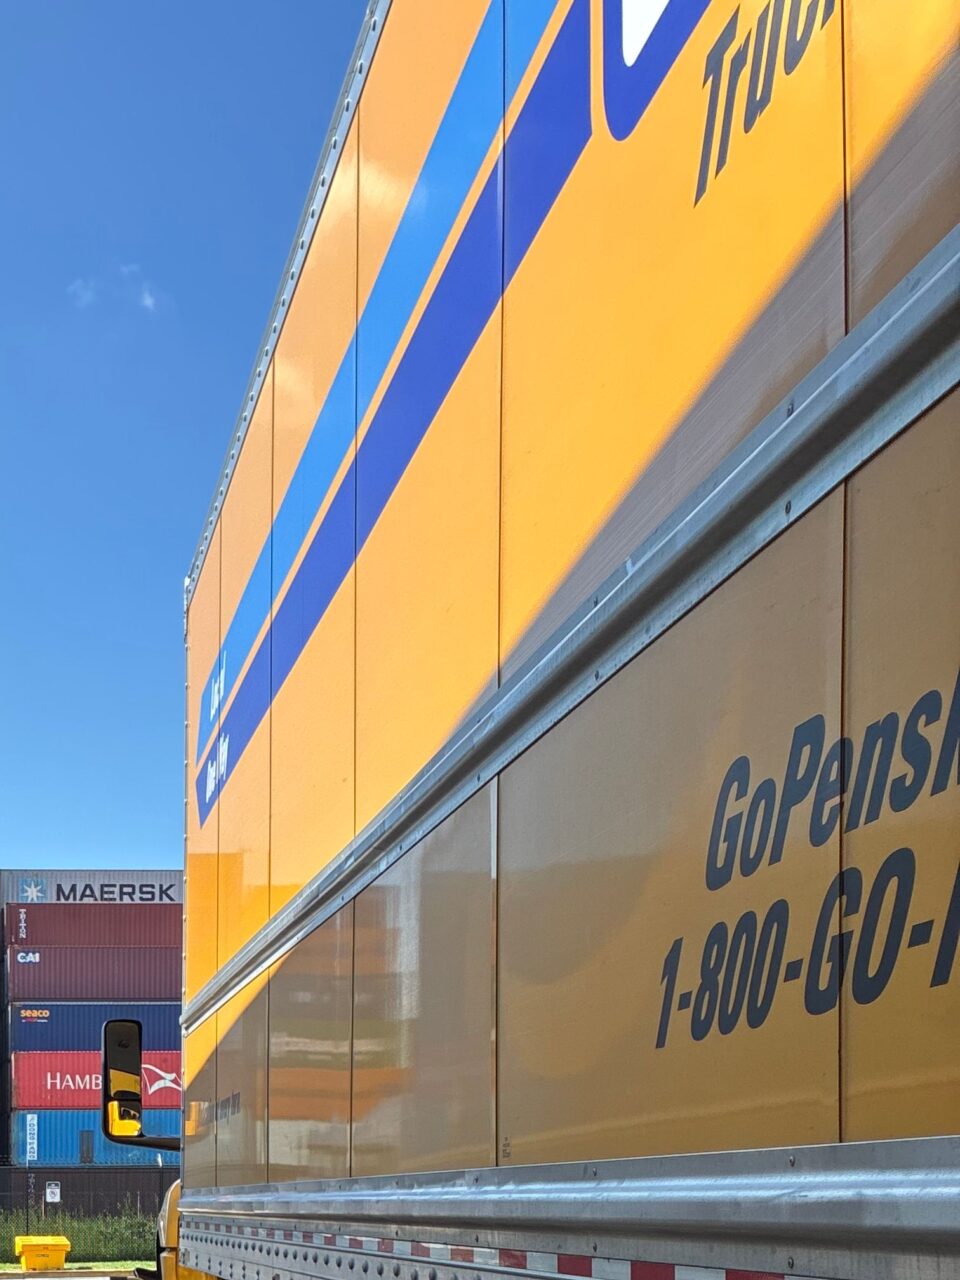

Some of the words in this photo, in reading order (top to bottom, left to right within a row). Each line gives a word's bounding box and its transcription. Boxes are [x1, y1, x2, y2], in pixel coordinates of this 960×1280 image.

[693, 0, 836, 209] Truc
[56, 883, 176, 902] MAERSK
[17, 952, 40, 963] CAI
[655, 847, 960, 1050] 1-800-GO-
[20, 1009, 50, 1018] seaco
[46, 1072, 103, 1090] HAMB
